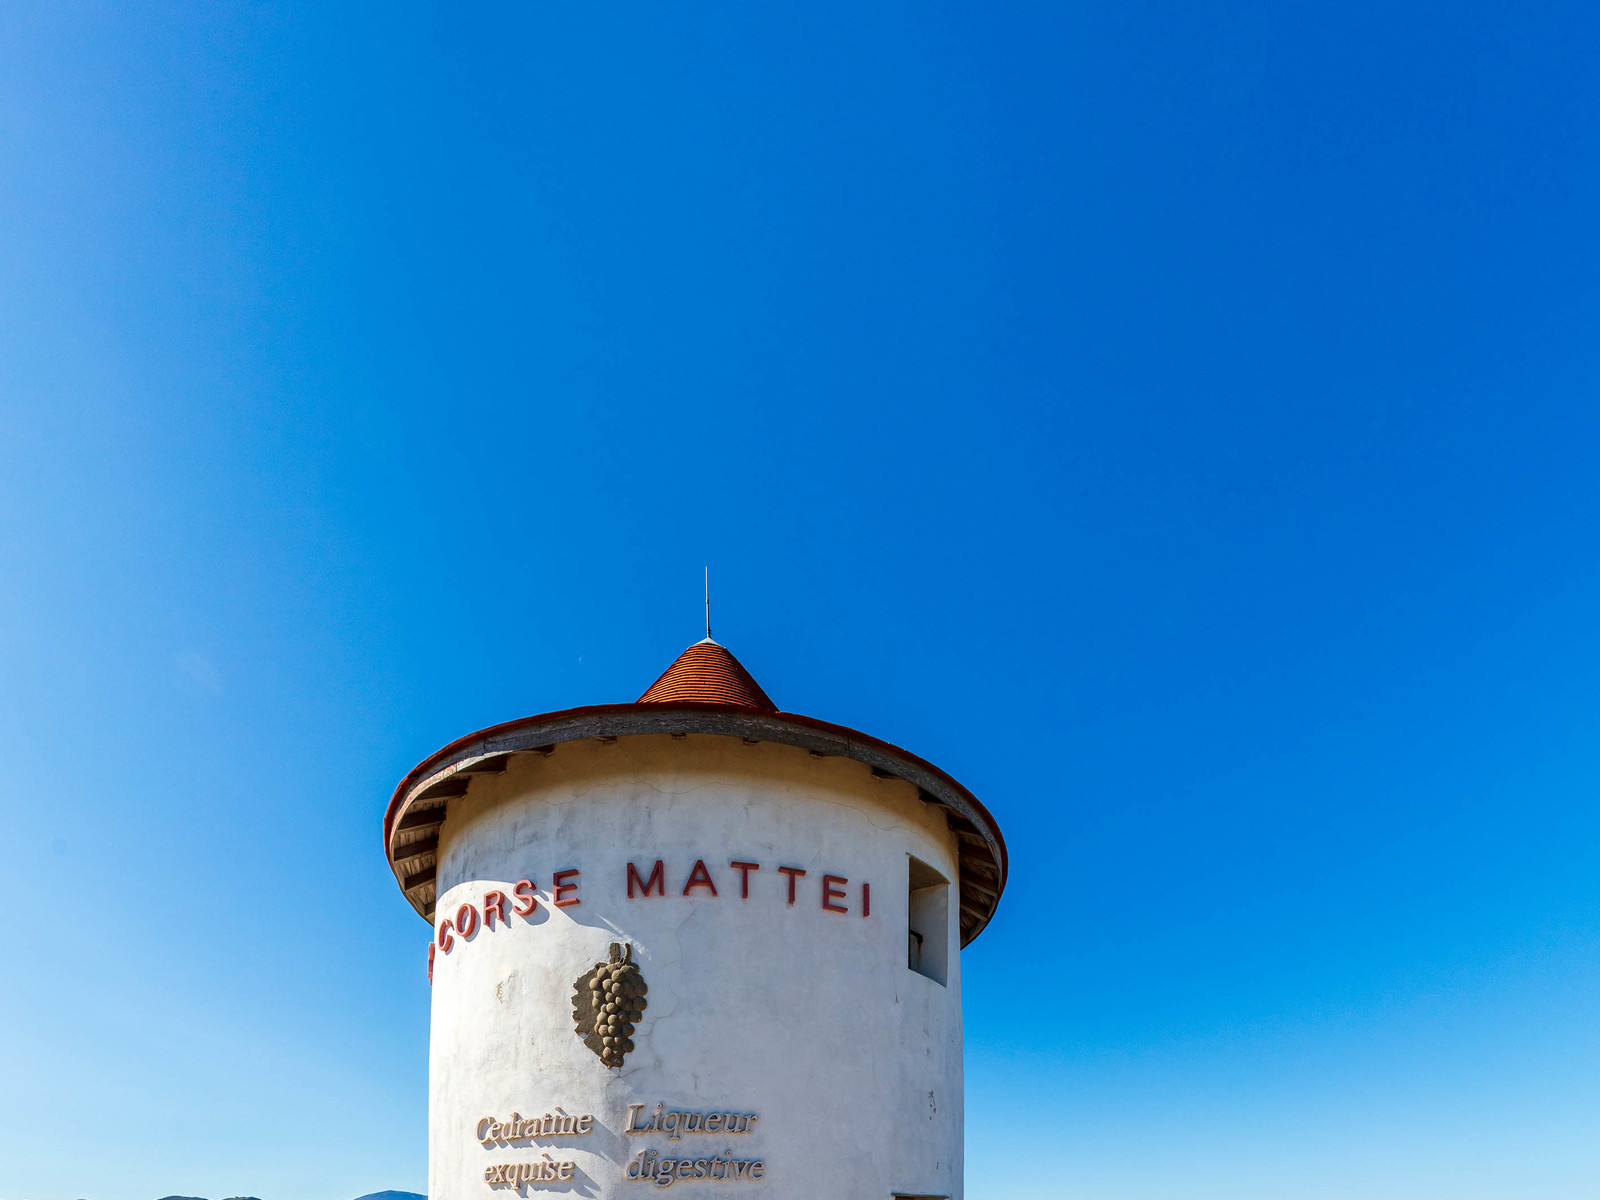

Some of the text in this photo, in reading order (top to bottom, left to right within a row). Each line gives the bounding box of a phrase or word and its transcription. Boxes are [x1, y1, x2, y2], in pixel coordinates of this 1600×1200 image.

[438, 859, 870, 953] CORSE MATTEI
[475, 1106, 594, 1144] Cedratine
[624, 1102, 759, 1141] Liqueur
[483, 1152, 576, 1190] exquise
[624, 1149, 767, 1189] digestive
